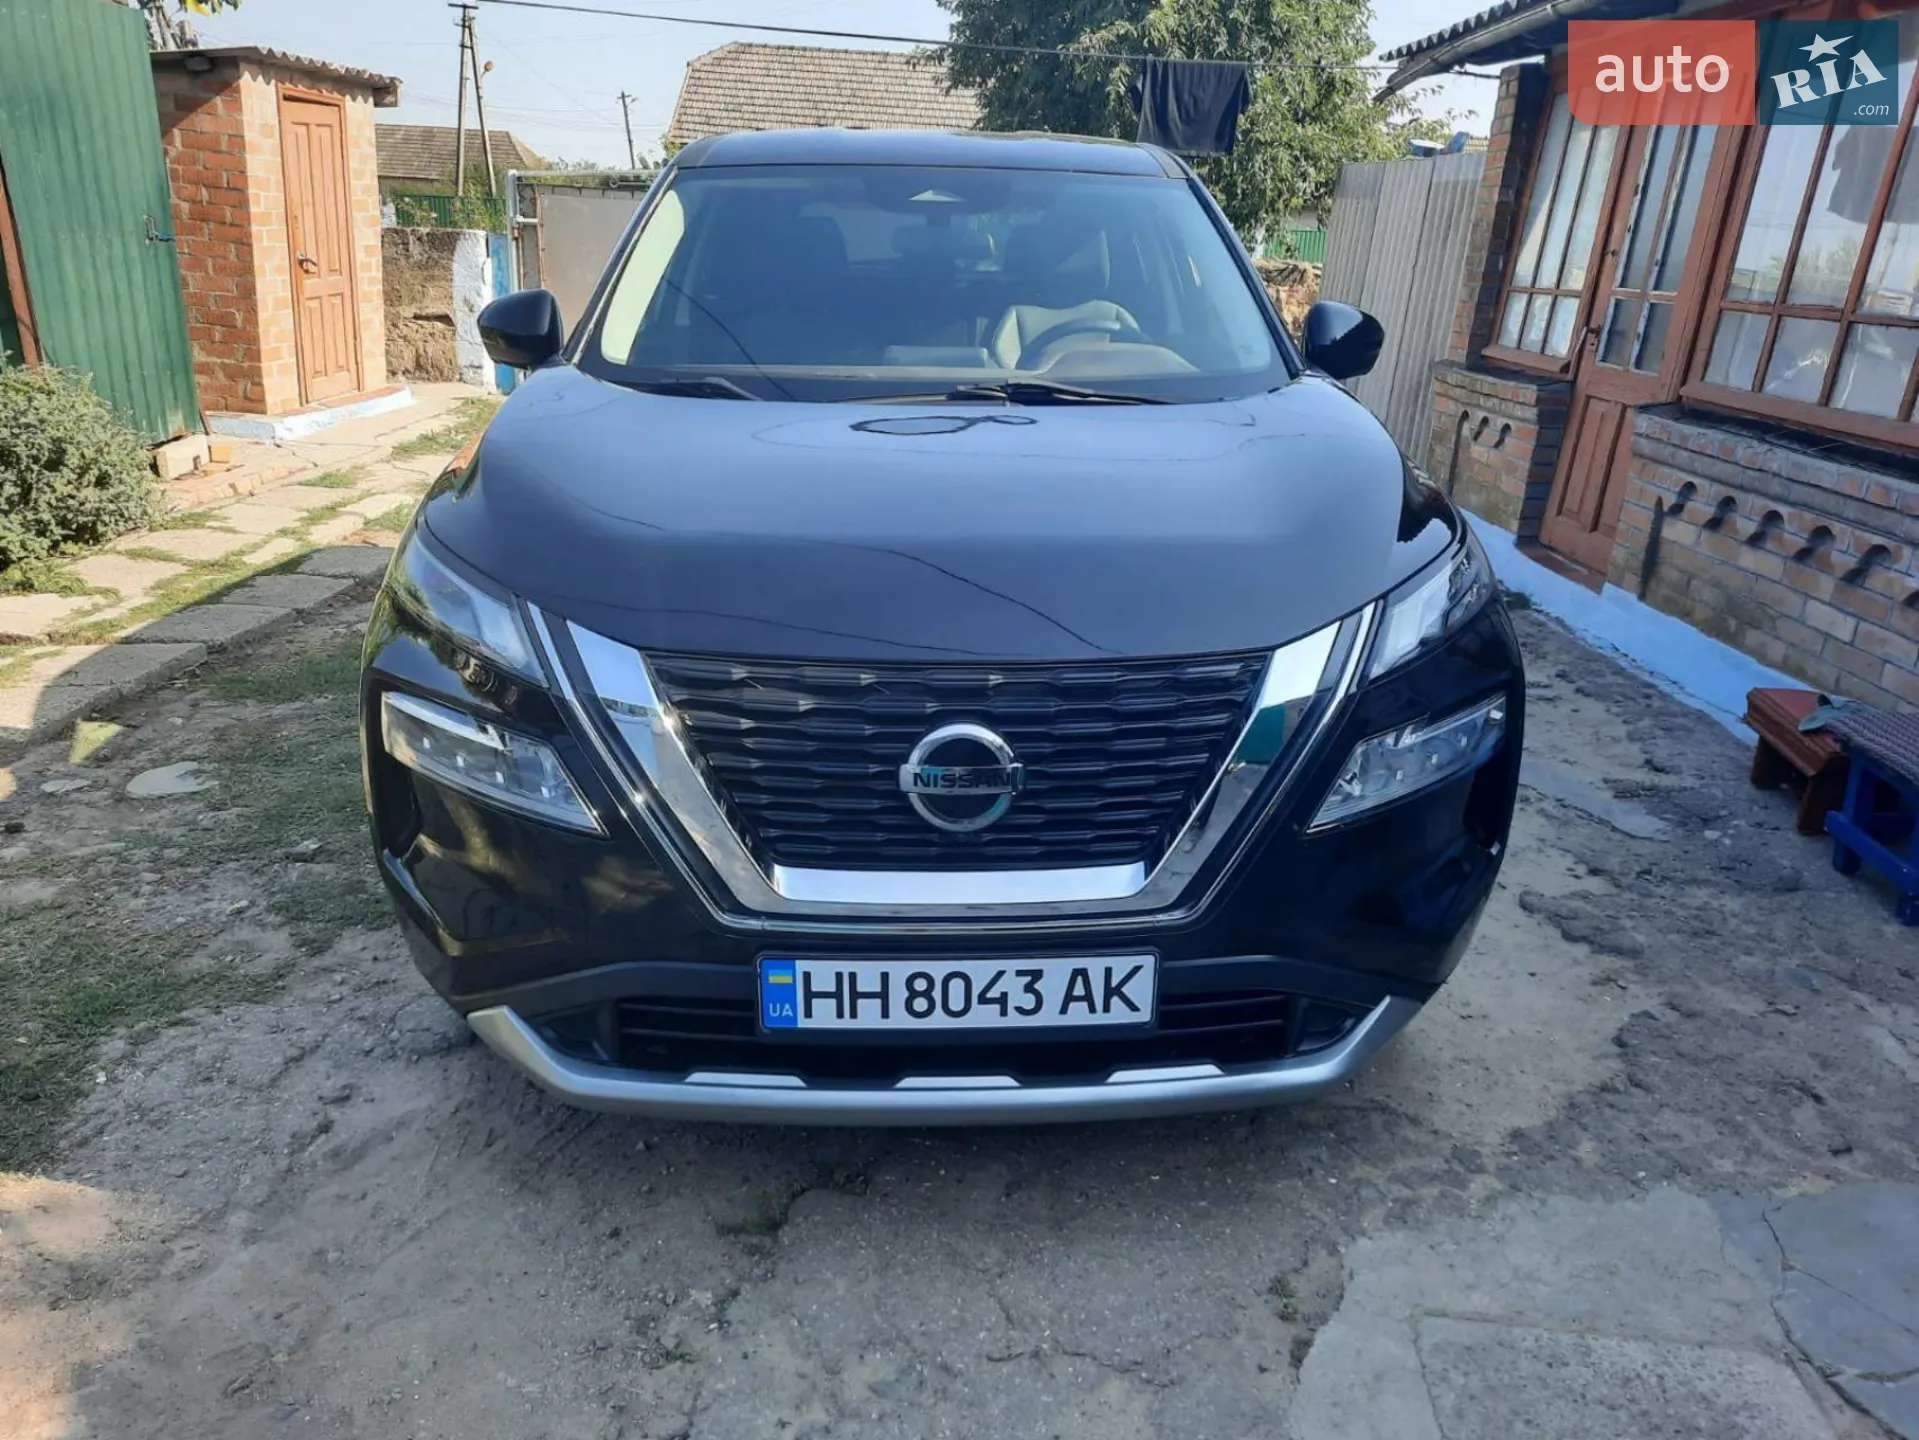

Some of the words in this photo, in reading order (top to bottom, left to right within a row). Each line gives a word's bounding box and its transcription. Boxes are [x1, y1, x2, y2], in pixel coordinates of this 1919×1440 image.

[913, 772, 1010, 788] NISSAN
[802, 971, 890, 1019] HH
[904, 969, 1044, 1019] 8043
[1058, 964, 1144, 1015] AK
[769, 1003, 794, 1017] UA
